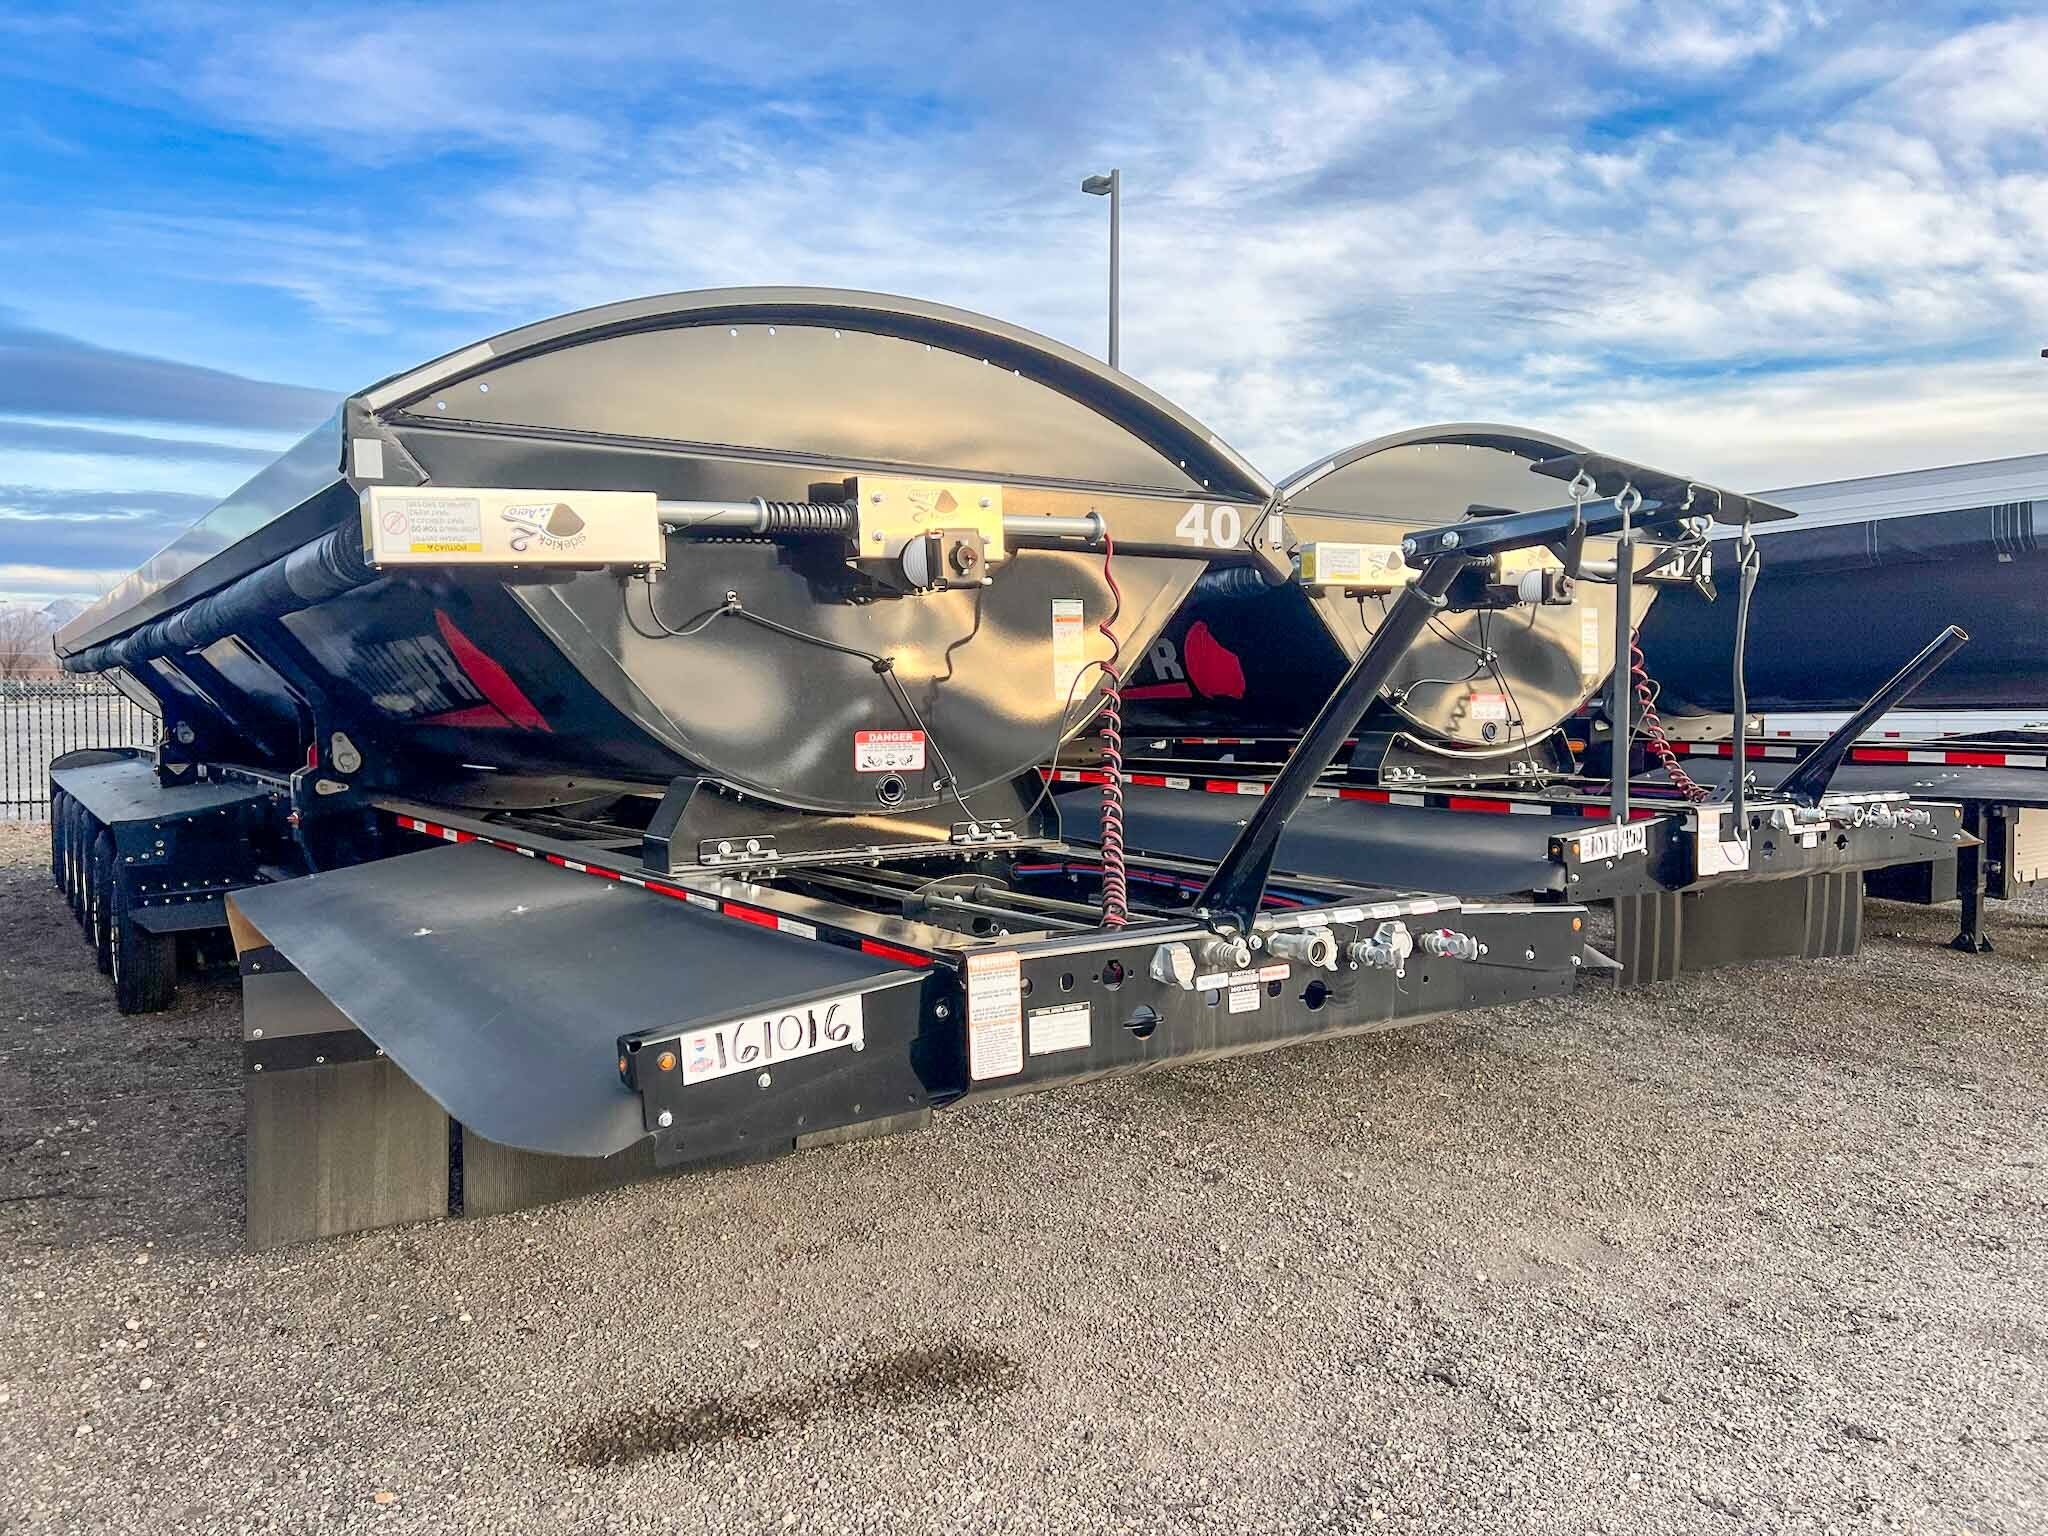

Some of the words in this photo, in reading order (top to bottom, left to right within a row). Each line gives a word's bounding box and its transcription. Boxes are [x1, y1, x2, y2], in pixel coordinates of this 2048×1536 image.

[1176, 503, 1241, 548] 40
[511, 527, 537, 551] 2
[538, 533, 587, 551] sidekick
[868, 733, 913, 742] DANGER
[1231, 969, 1256, 977] NOTICE
[1230, 983, 1257, 992] NOTICE
[714, 1003, 851, 1069] 161016
